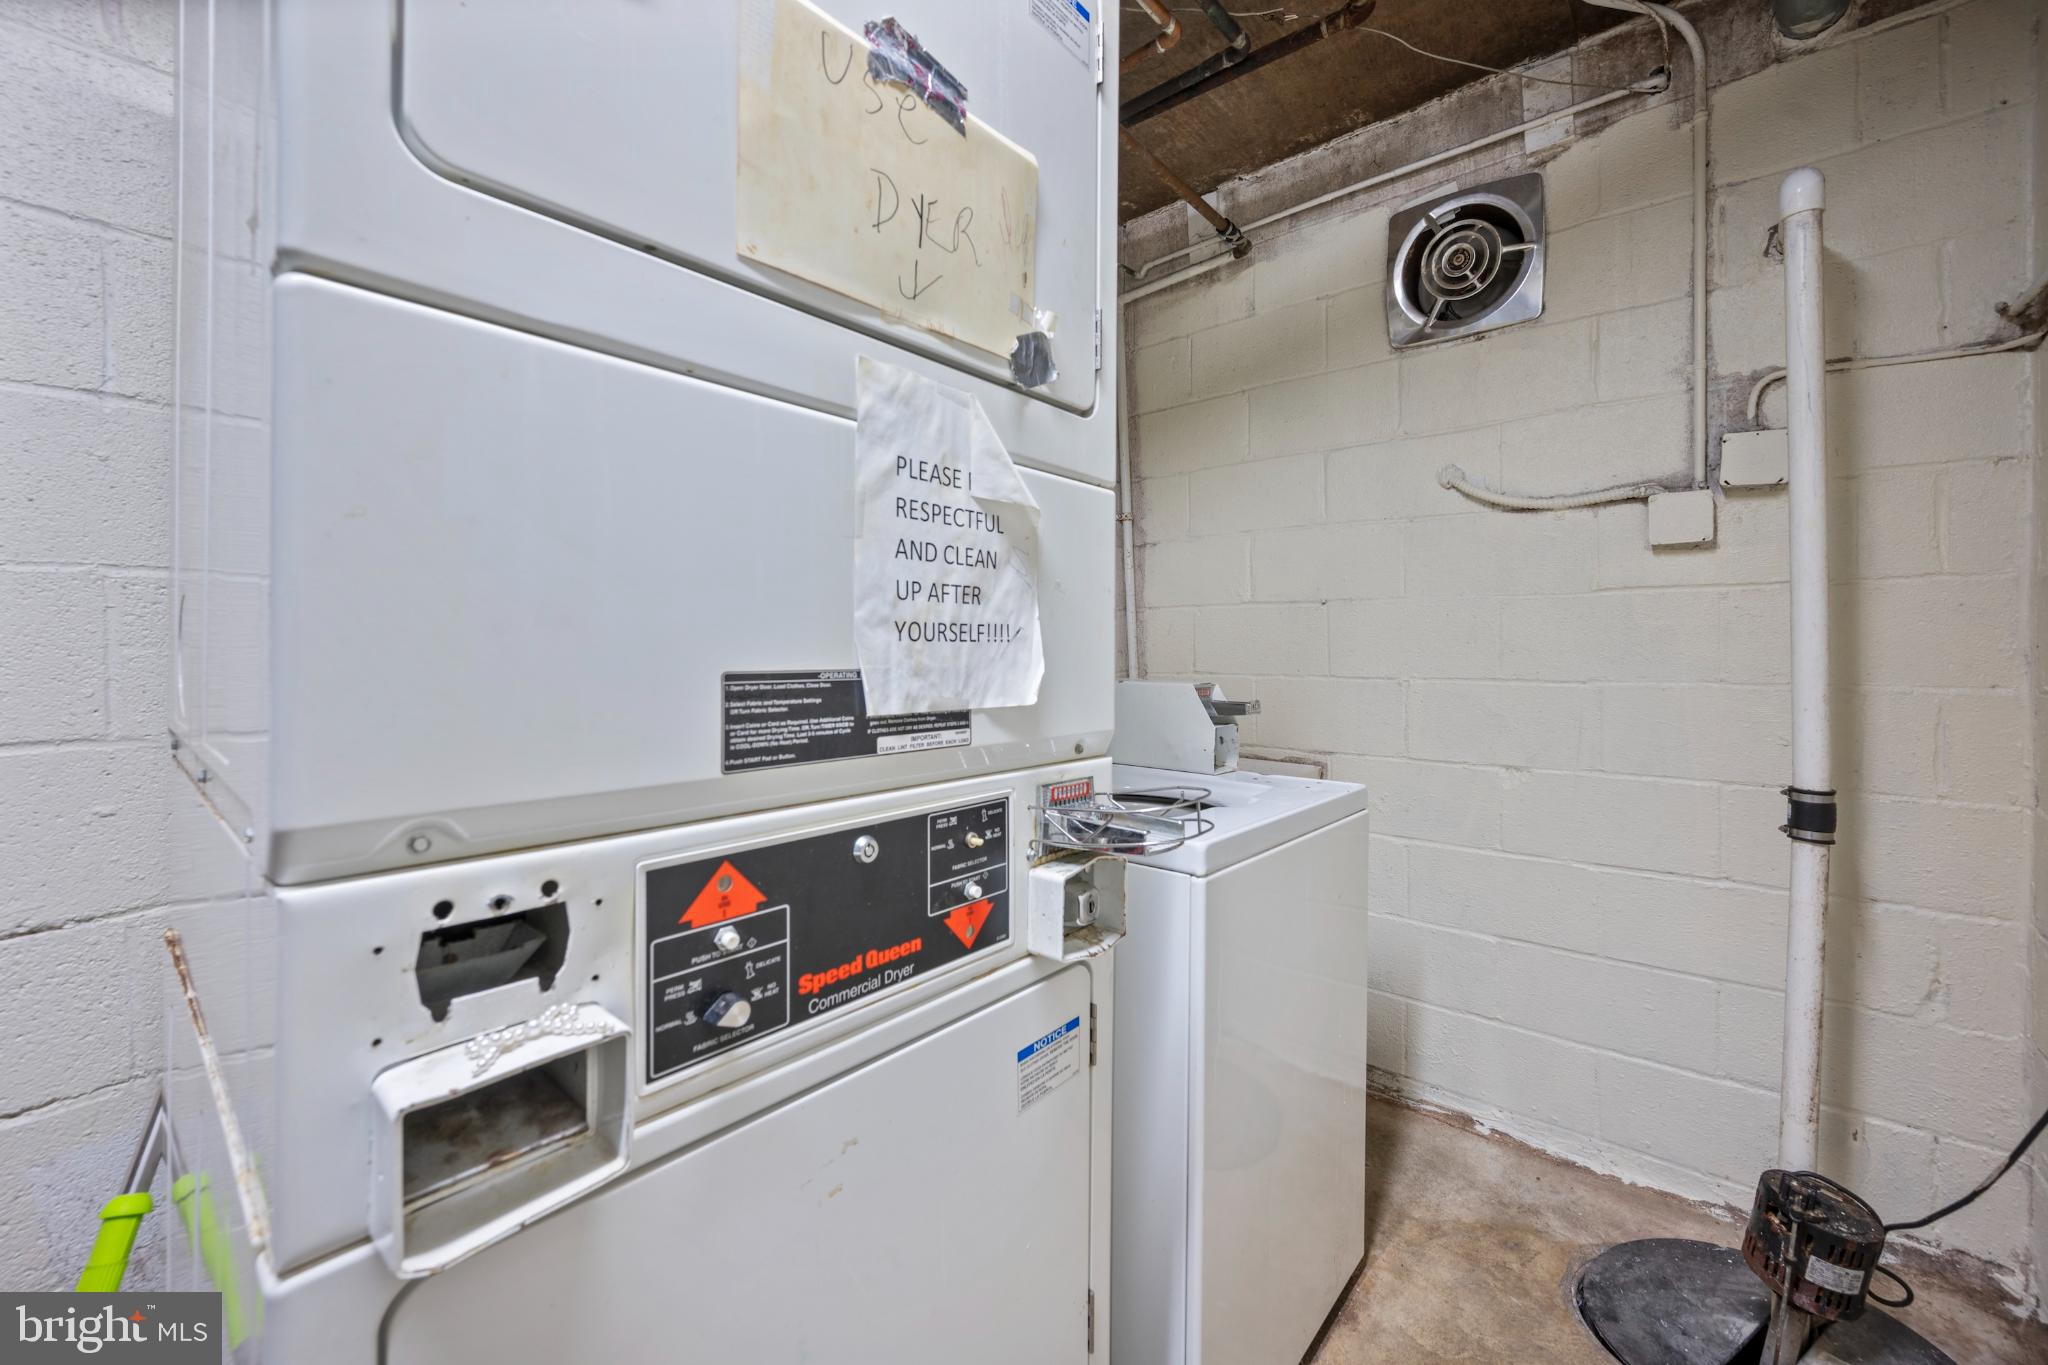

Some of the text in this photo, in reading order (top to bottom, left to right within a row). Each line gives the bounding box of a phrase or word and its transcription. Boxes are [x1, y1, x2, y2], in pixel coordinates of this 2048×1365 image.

[870, 168, 982, 266] DYER
[897, 456, 962, 490] PLEASE
[896, 497, 1004, 534] RESPECTFUL
[895, 539, 997, 570] AND CLEAN
[896, 580, 981, 605] UP AFTER
[895, 621, 1011, 644] YOURSELF!!!!
[798, 938, 922, 995] Speed Queen
[808, 963, 915, 1014] Commercial Dryer
[1033, 1025, 1067, 1052] NOTICE
